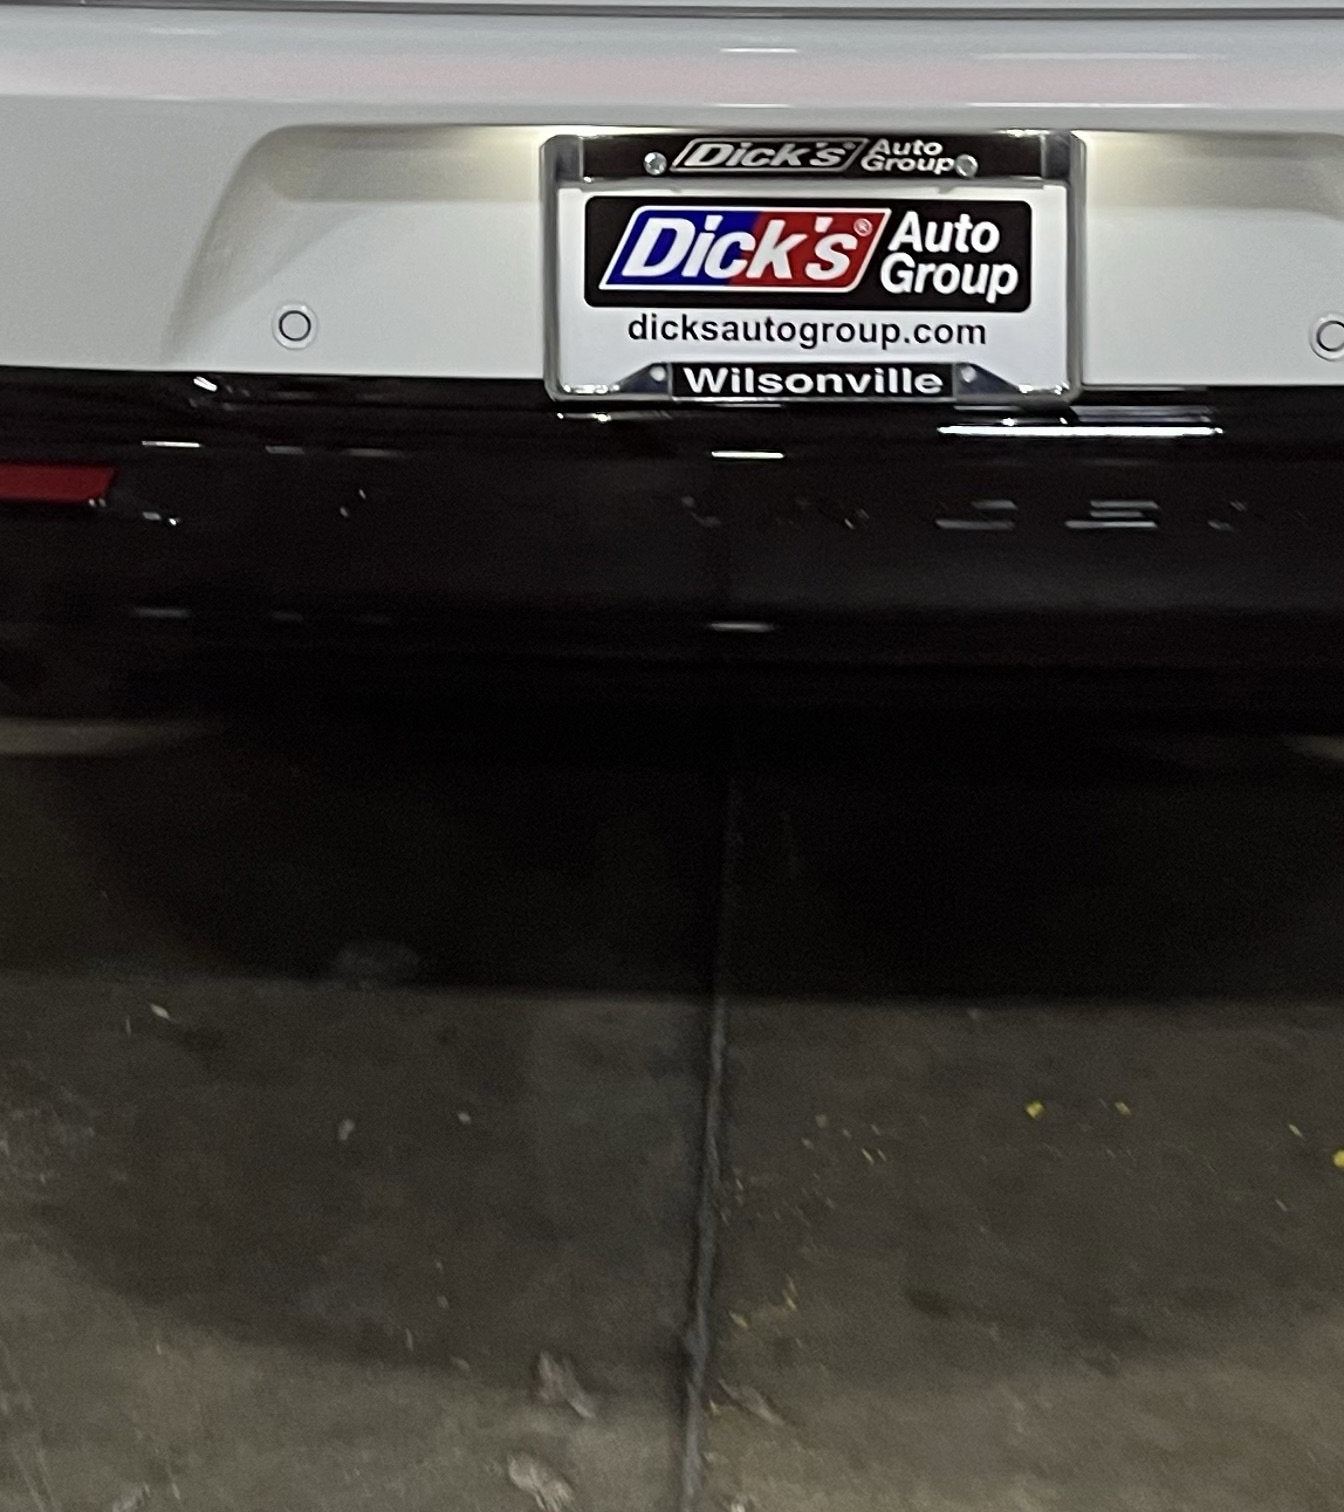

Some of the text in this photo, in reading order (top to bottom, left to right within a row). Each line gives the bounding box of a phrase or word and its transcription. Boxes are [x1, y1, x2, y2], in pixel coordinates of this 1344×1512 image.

[684, 142, 847, 167] Dick's
[869, 139, 943, 156] Auto
[860, 154, 956, 175] Group
[621, 215, 857, 281] Dick's
[888, 210, 1000, 254] Auto
[880, 254, 1018, 303] Group
[627, 313, 987, 350] dicksautogroup.com
[683, 366, 945, 394] Wilsonville
